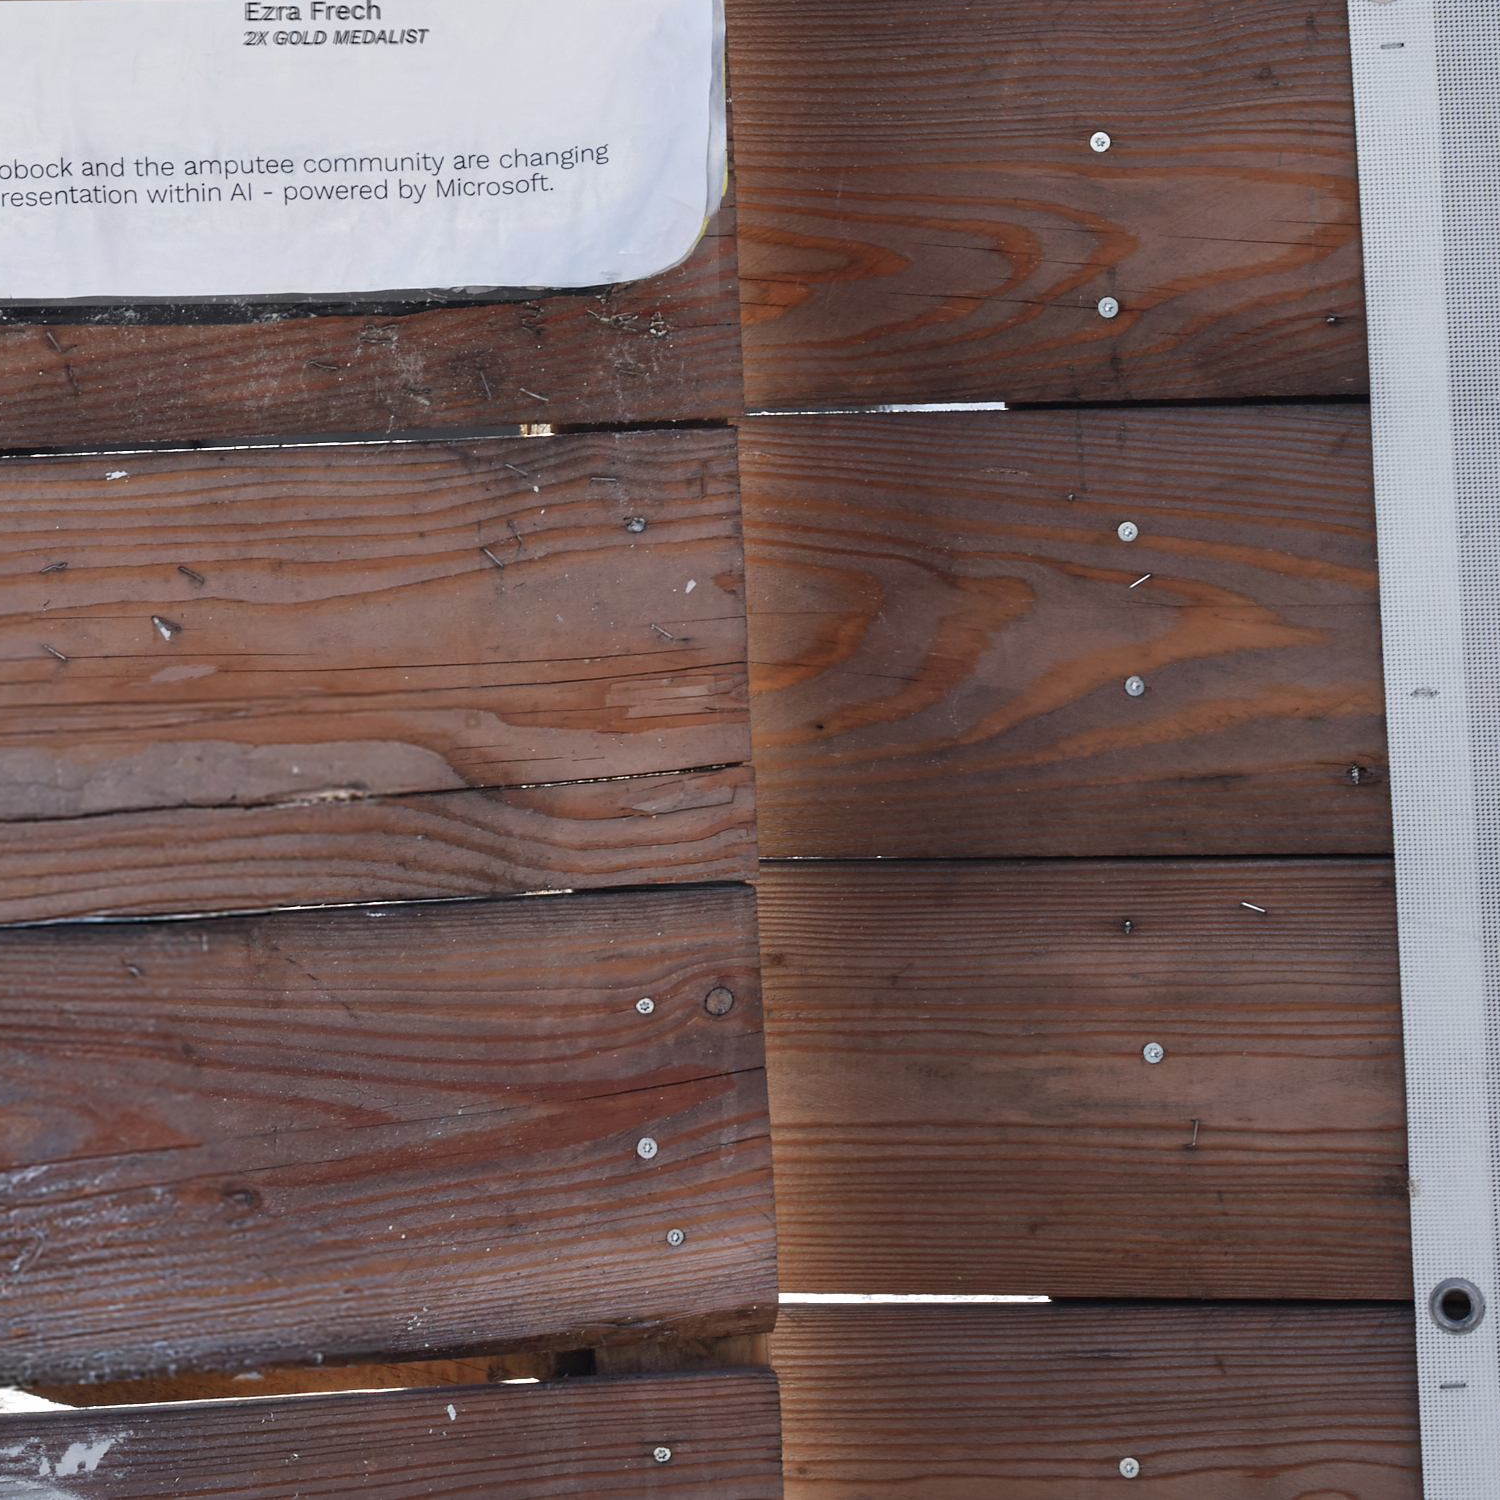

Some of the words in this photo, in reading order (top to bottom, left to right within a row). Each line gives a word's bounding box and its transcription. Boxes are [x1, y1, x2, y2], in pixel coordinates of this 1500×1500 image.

[244, 1, 302, 21] Ezra
[310, 0, 381, 21] Frech
[243, 30, 269, 46] 2X
[273, 29, 327, 45] GOLD
[333, 28, 429, 45] MEDALIST
[82, 157, 124, 177] and
[134, 157, 174, 176] the
[185, 157, 293, 179] amputee
[304, 153, 444, 176] community
[454, 155, 489, 170] are
[500, 144, 608, 169] changing
[147, 183, 221, 203] within
[231, 183, 251, 201] AI
[284, 179, 387, 205] powered
[399, 179, 426, 204] by
[436, 172, 555, 198] Microsoft.
